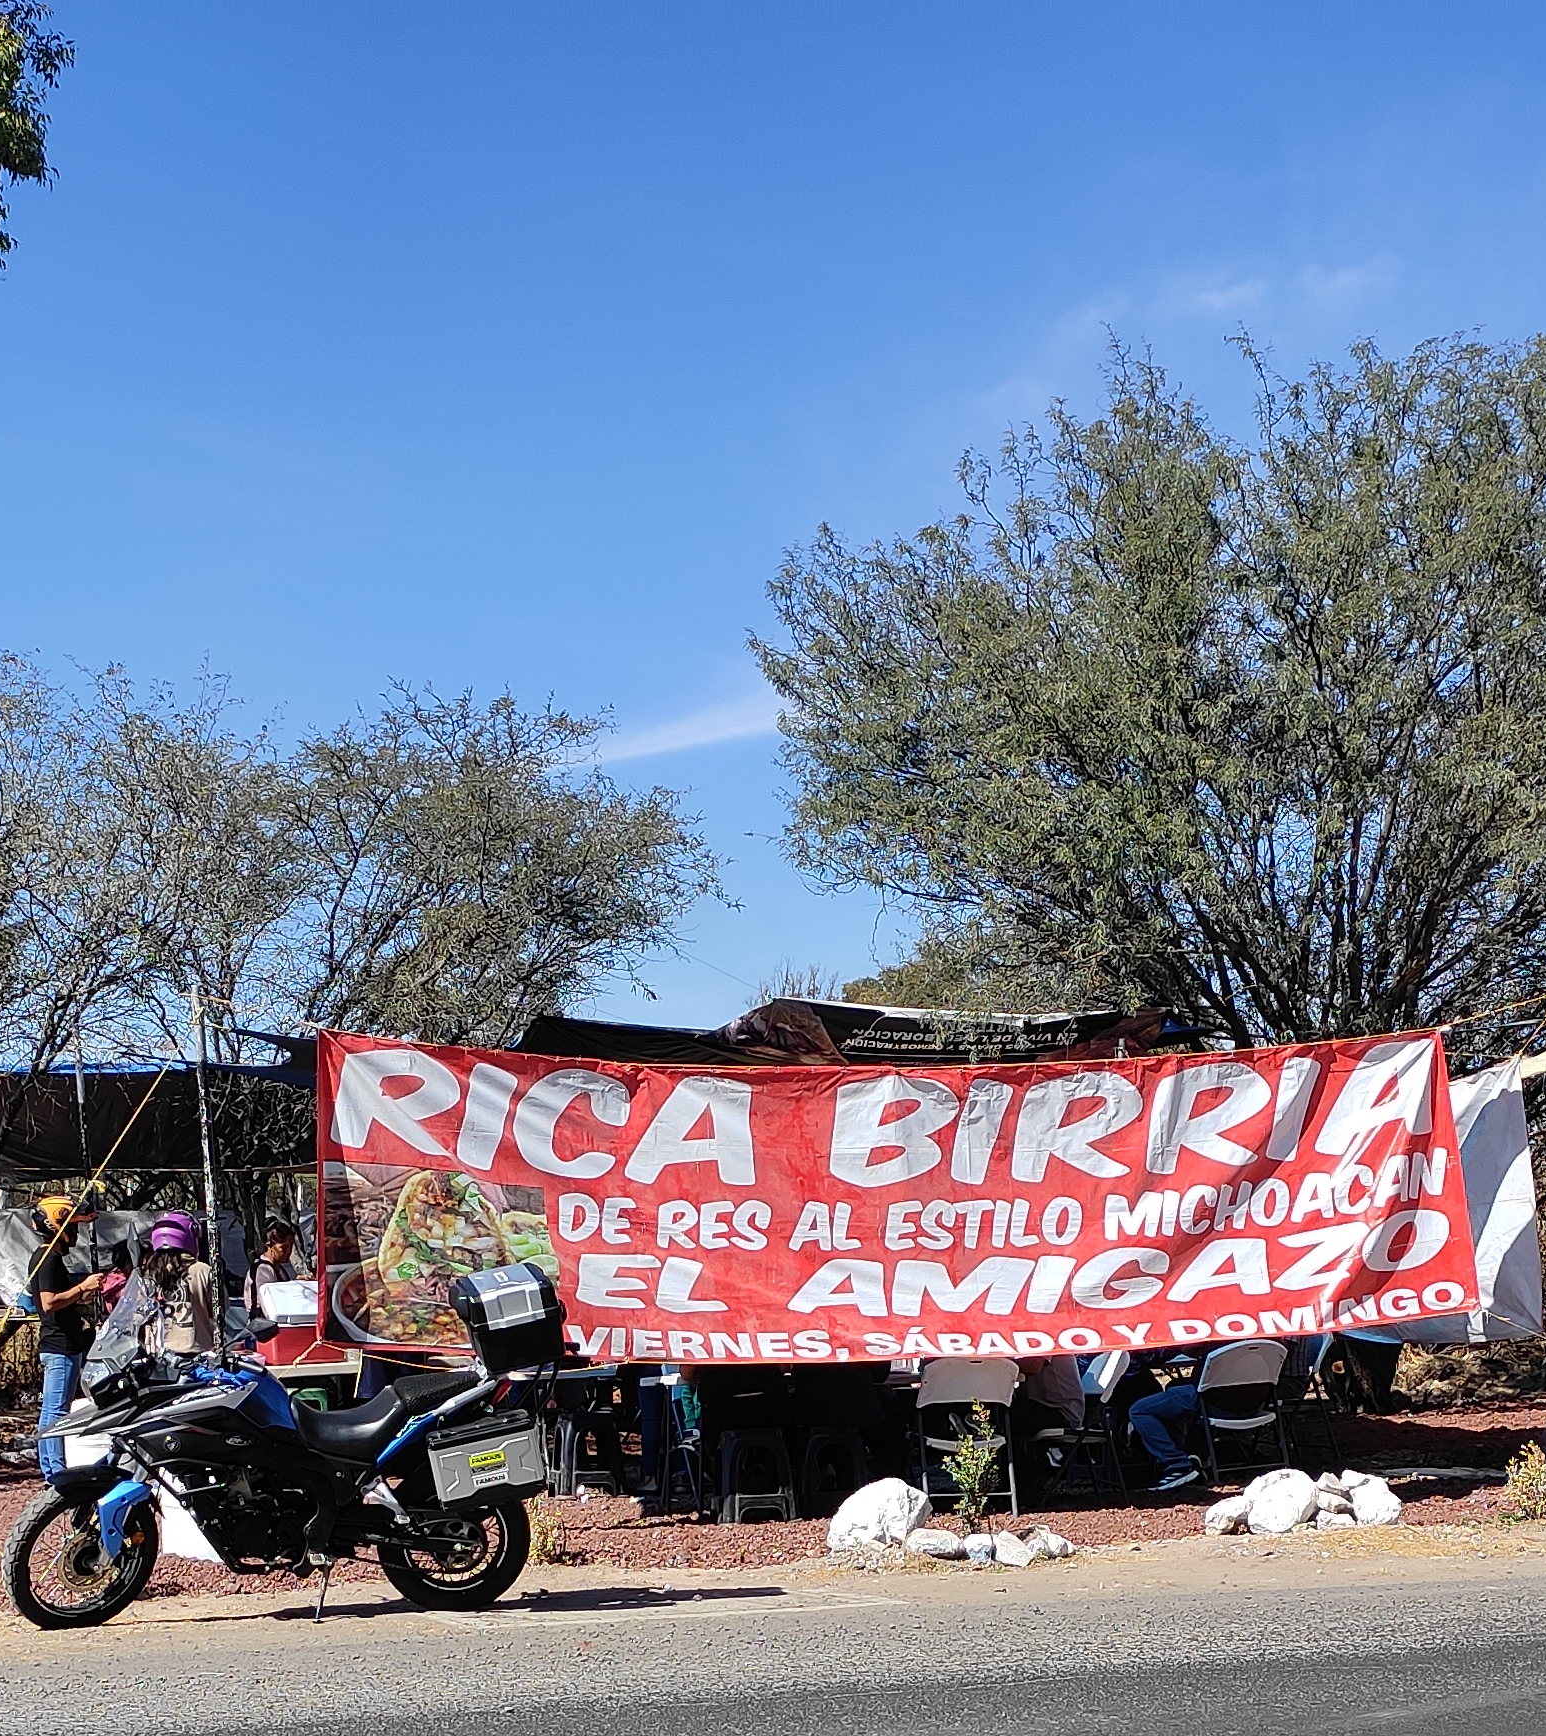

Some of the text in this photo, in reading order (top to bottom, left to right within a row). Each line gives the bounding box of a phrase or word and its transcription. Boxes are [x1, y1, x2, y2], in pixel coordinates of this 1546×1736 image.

[330, 1038, 1436, 1188] RICA BIRRIA
[558, 1147, 1448, 1252] DE RES AL ESTILO MICHOACAN
[575, 1208, 1451, 1318] EL AMIGAZO
[566, 1281, 1466, 1361] VIERNES, SÁBADO Y DOMINGO
